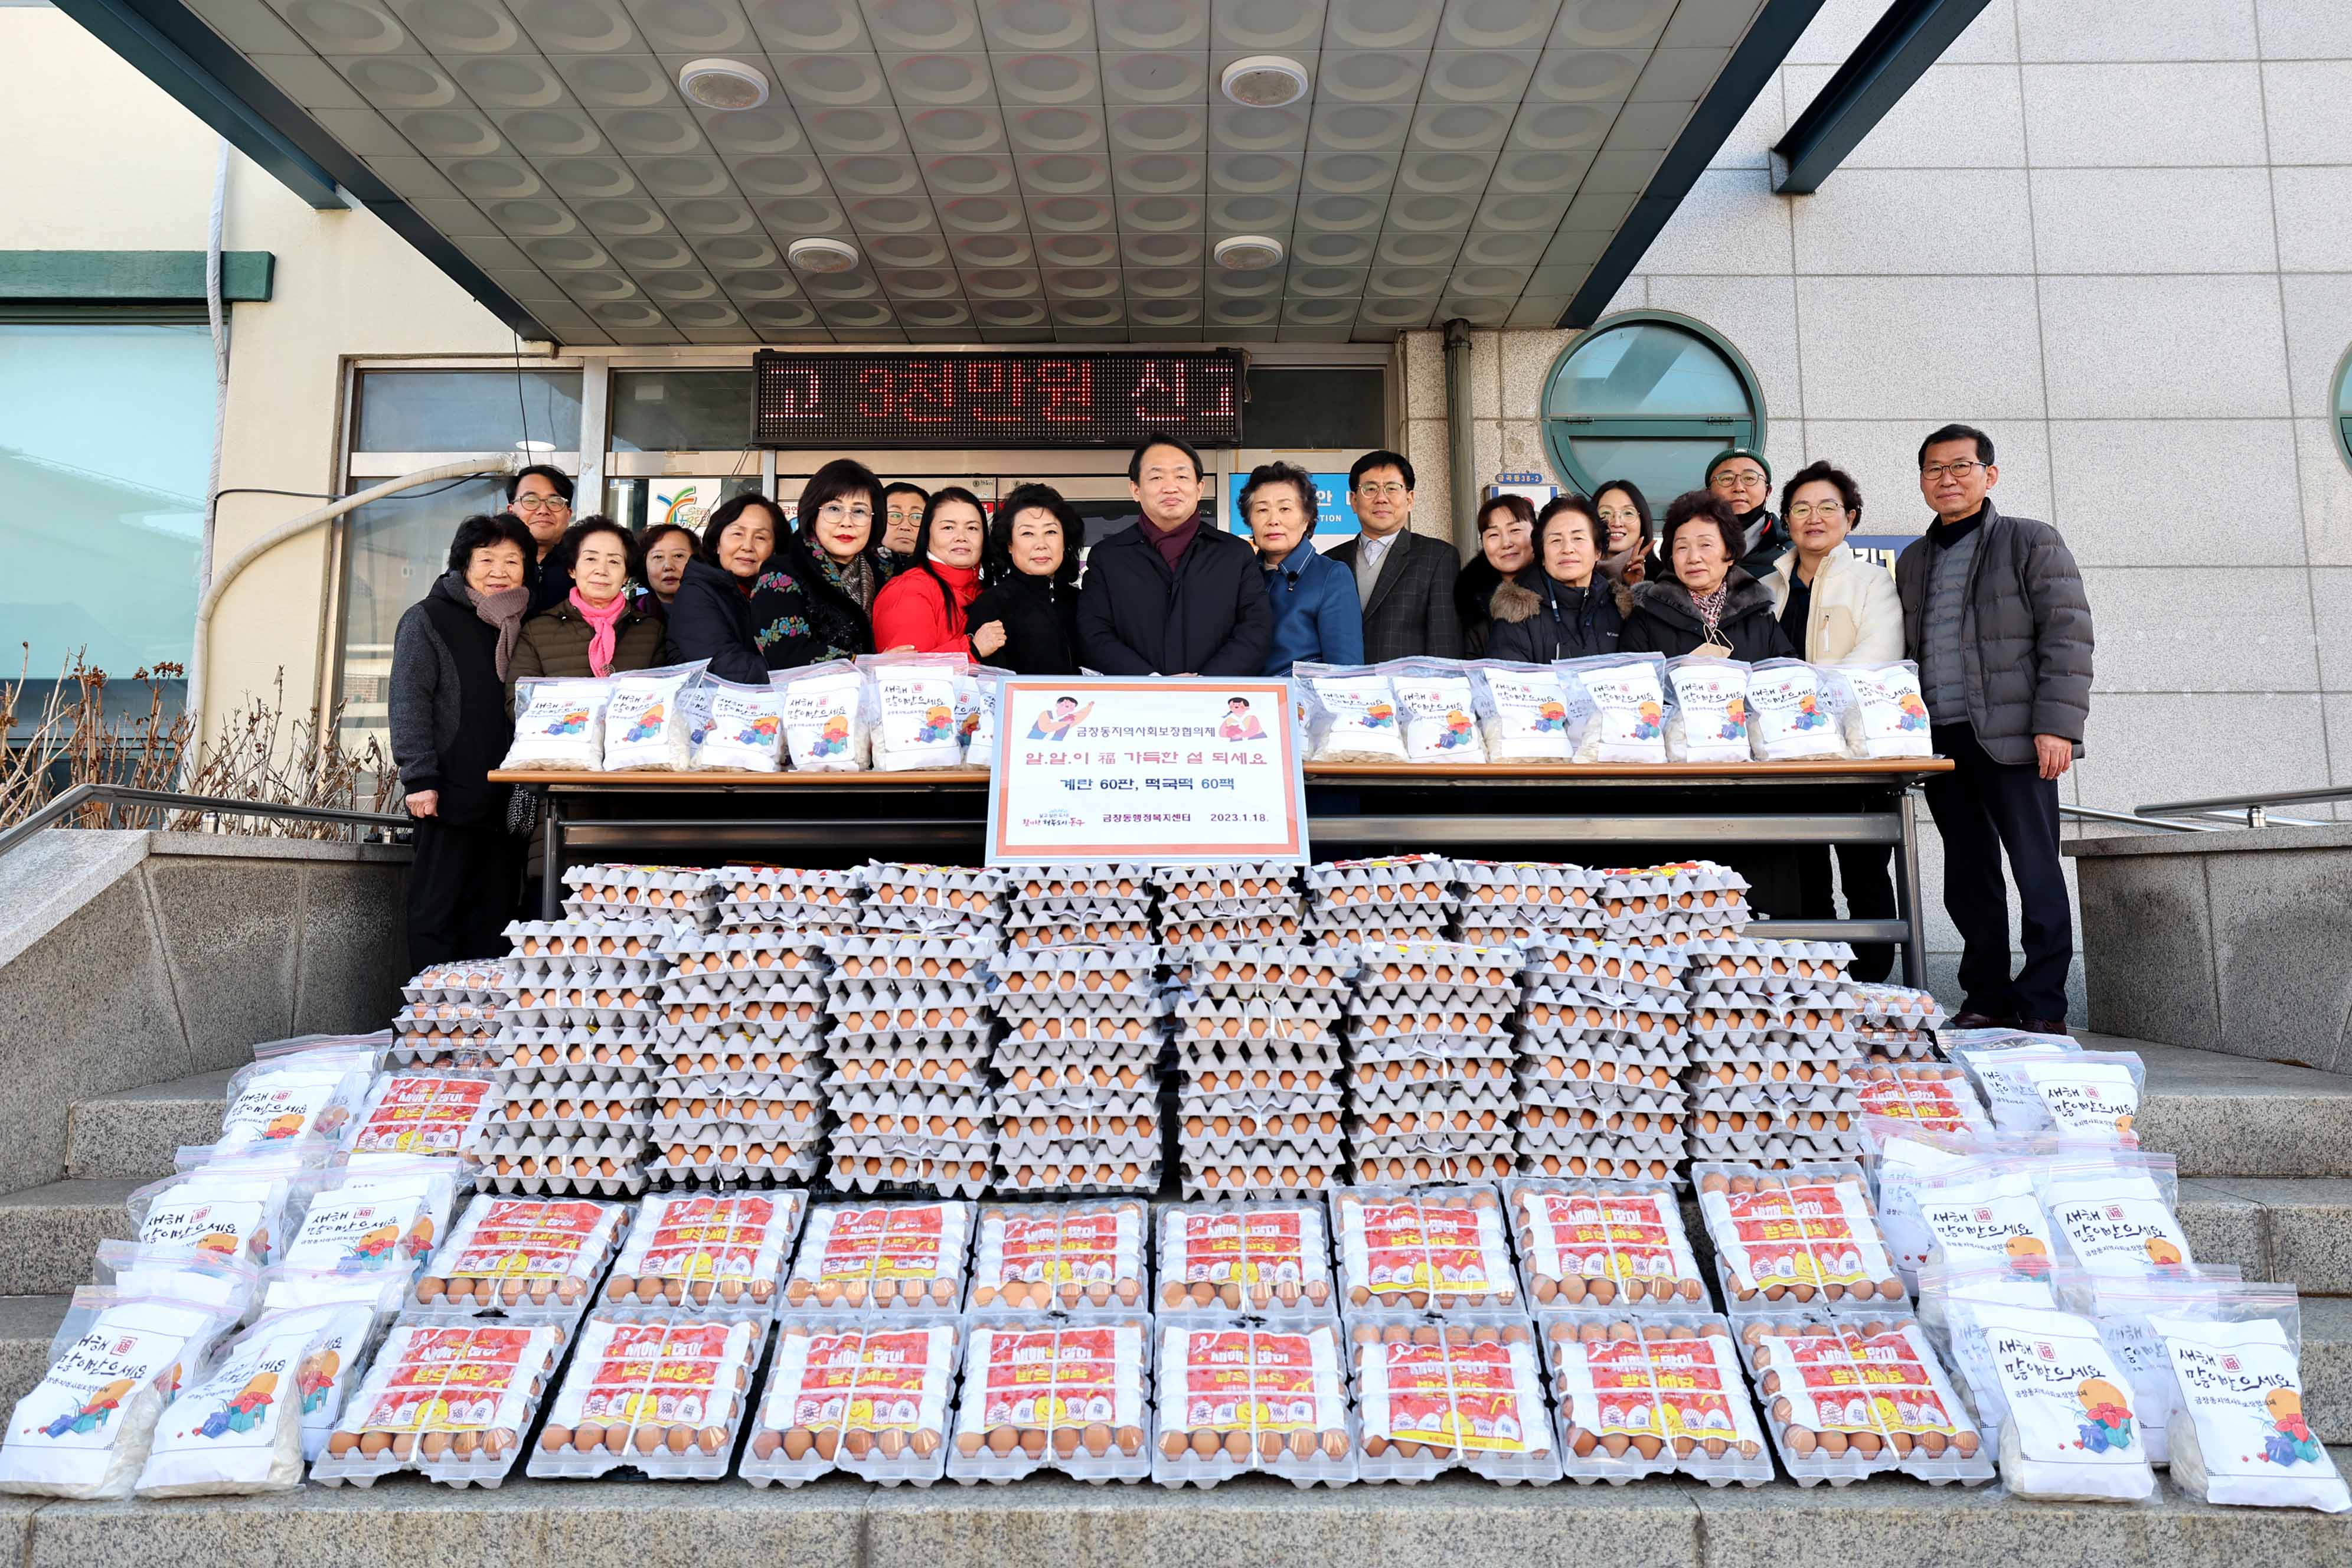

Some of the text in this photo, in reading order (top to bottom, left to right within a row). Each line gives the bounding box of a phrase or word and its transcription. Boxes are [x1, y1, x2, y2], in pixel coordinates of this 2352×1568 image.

[859, 362, 1091, 421] 3천만원
[1077, 726, 1215, 737] 금창동지역사회보장협의체
[1025, 752, 1267, 765] 알.알.이 福 가득한 설 되세요
[1060, 778, 1234, 790] 계란 60판, 떡국떡 60팩
[1103, 813, 1191, 822] 금창동행정복지센터
[1210, 813, 1268, 822] 2023.1.18.
